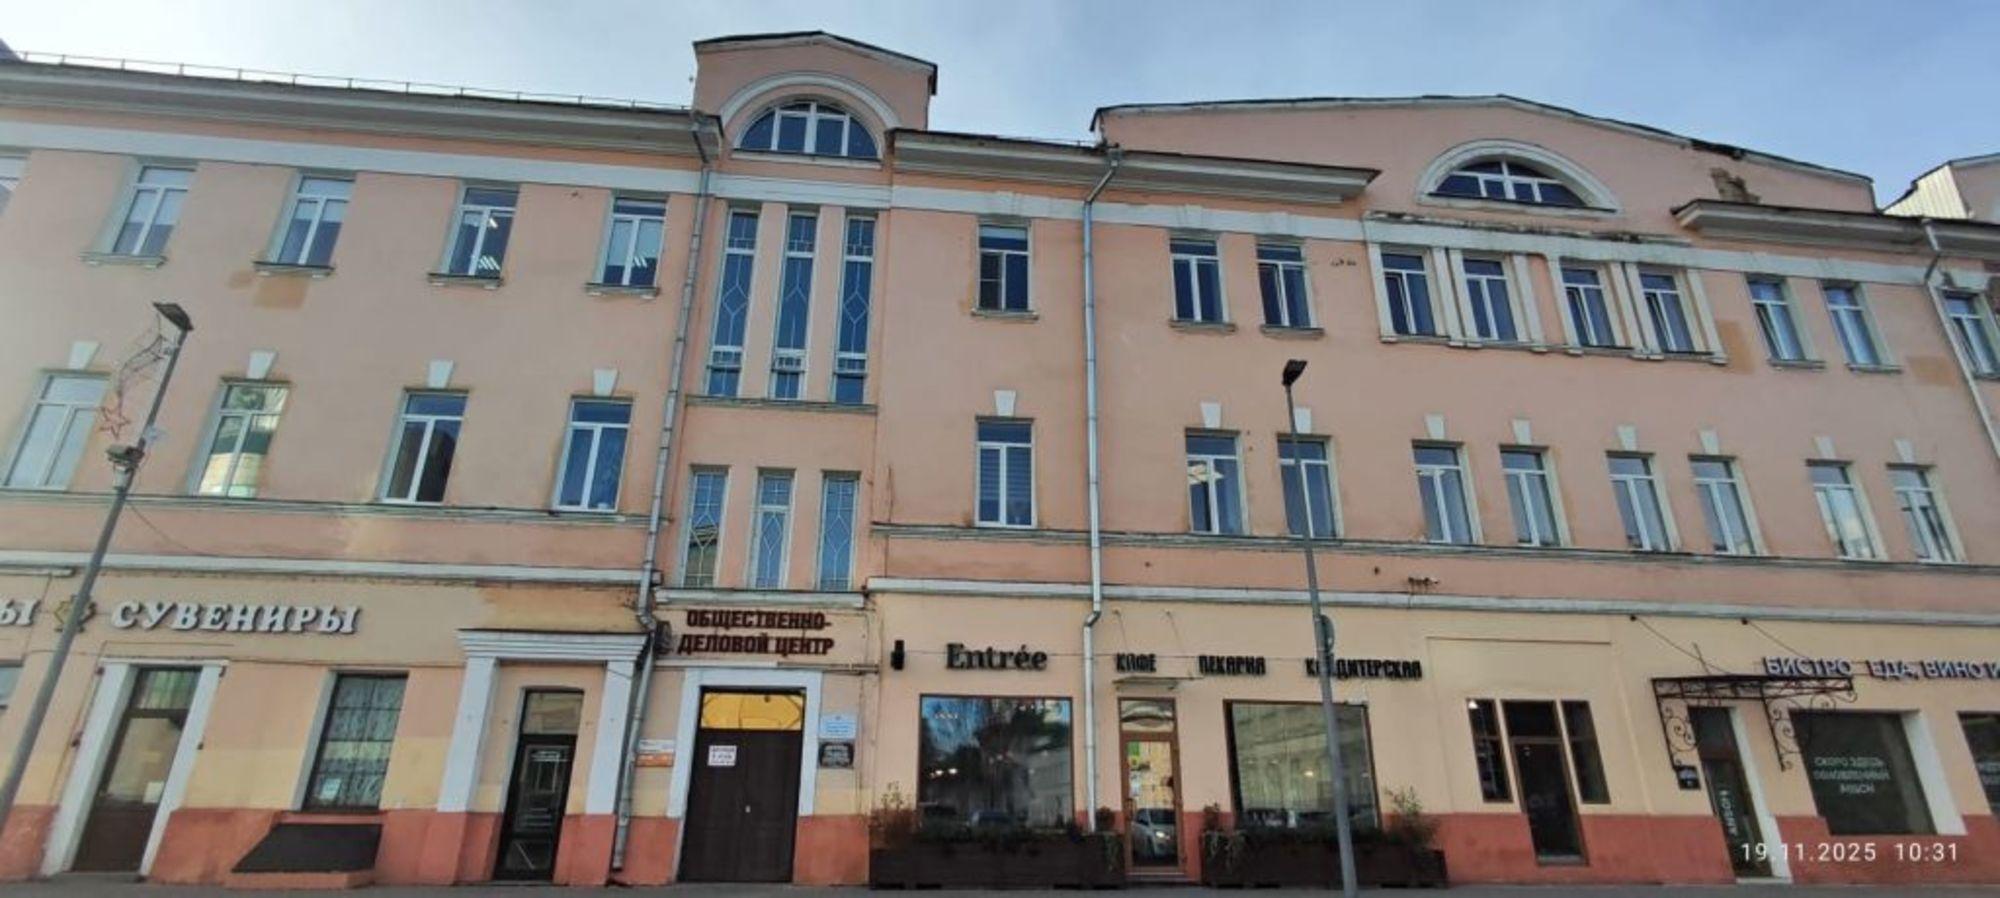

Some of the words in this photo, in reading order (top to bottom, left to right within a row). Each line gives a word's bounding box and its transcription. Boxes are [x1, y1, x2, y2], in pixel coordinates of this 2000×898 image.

[111, 601, 362, 635] СУВЕНИРЫ
[686, 609, 832, 630] ОБЩЕСТВЕННО-
[677, 632, 769, 656] ДЕЛОВОЙ
[775, 636, 835, 658] ЦЕНТР
[946, 643, 1048, 671] Entrée
[1116, 653, 1157, 673] КАФЕ
[1198, 655, 1267, 676] ПЕКАРНЯ
[1304, 658, 1422, 680] КДИТЕРСКАЯ
[1763, 656, 1852, 678] БИСТРО
[1866, 659, 1918, 680] ЕДА,
[1920, 659, 1984, 679] ВИНО
